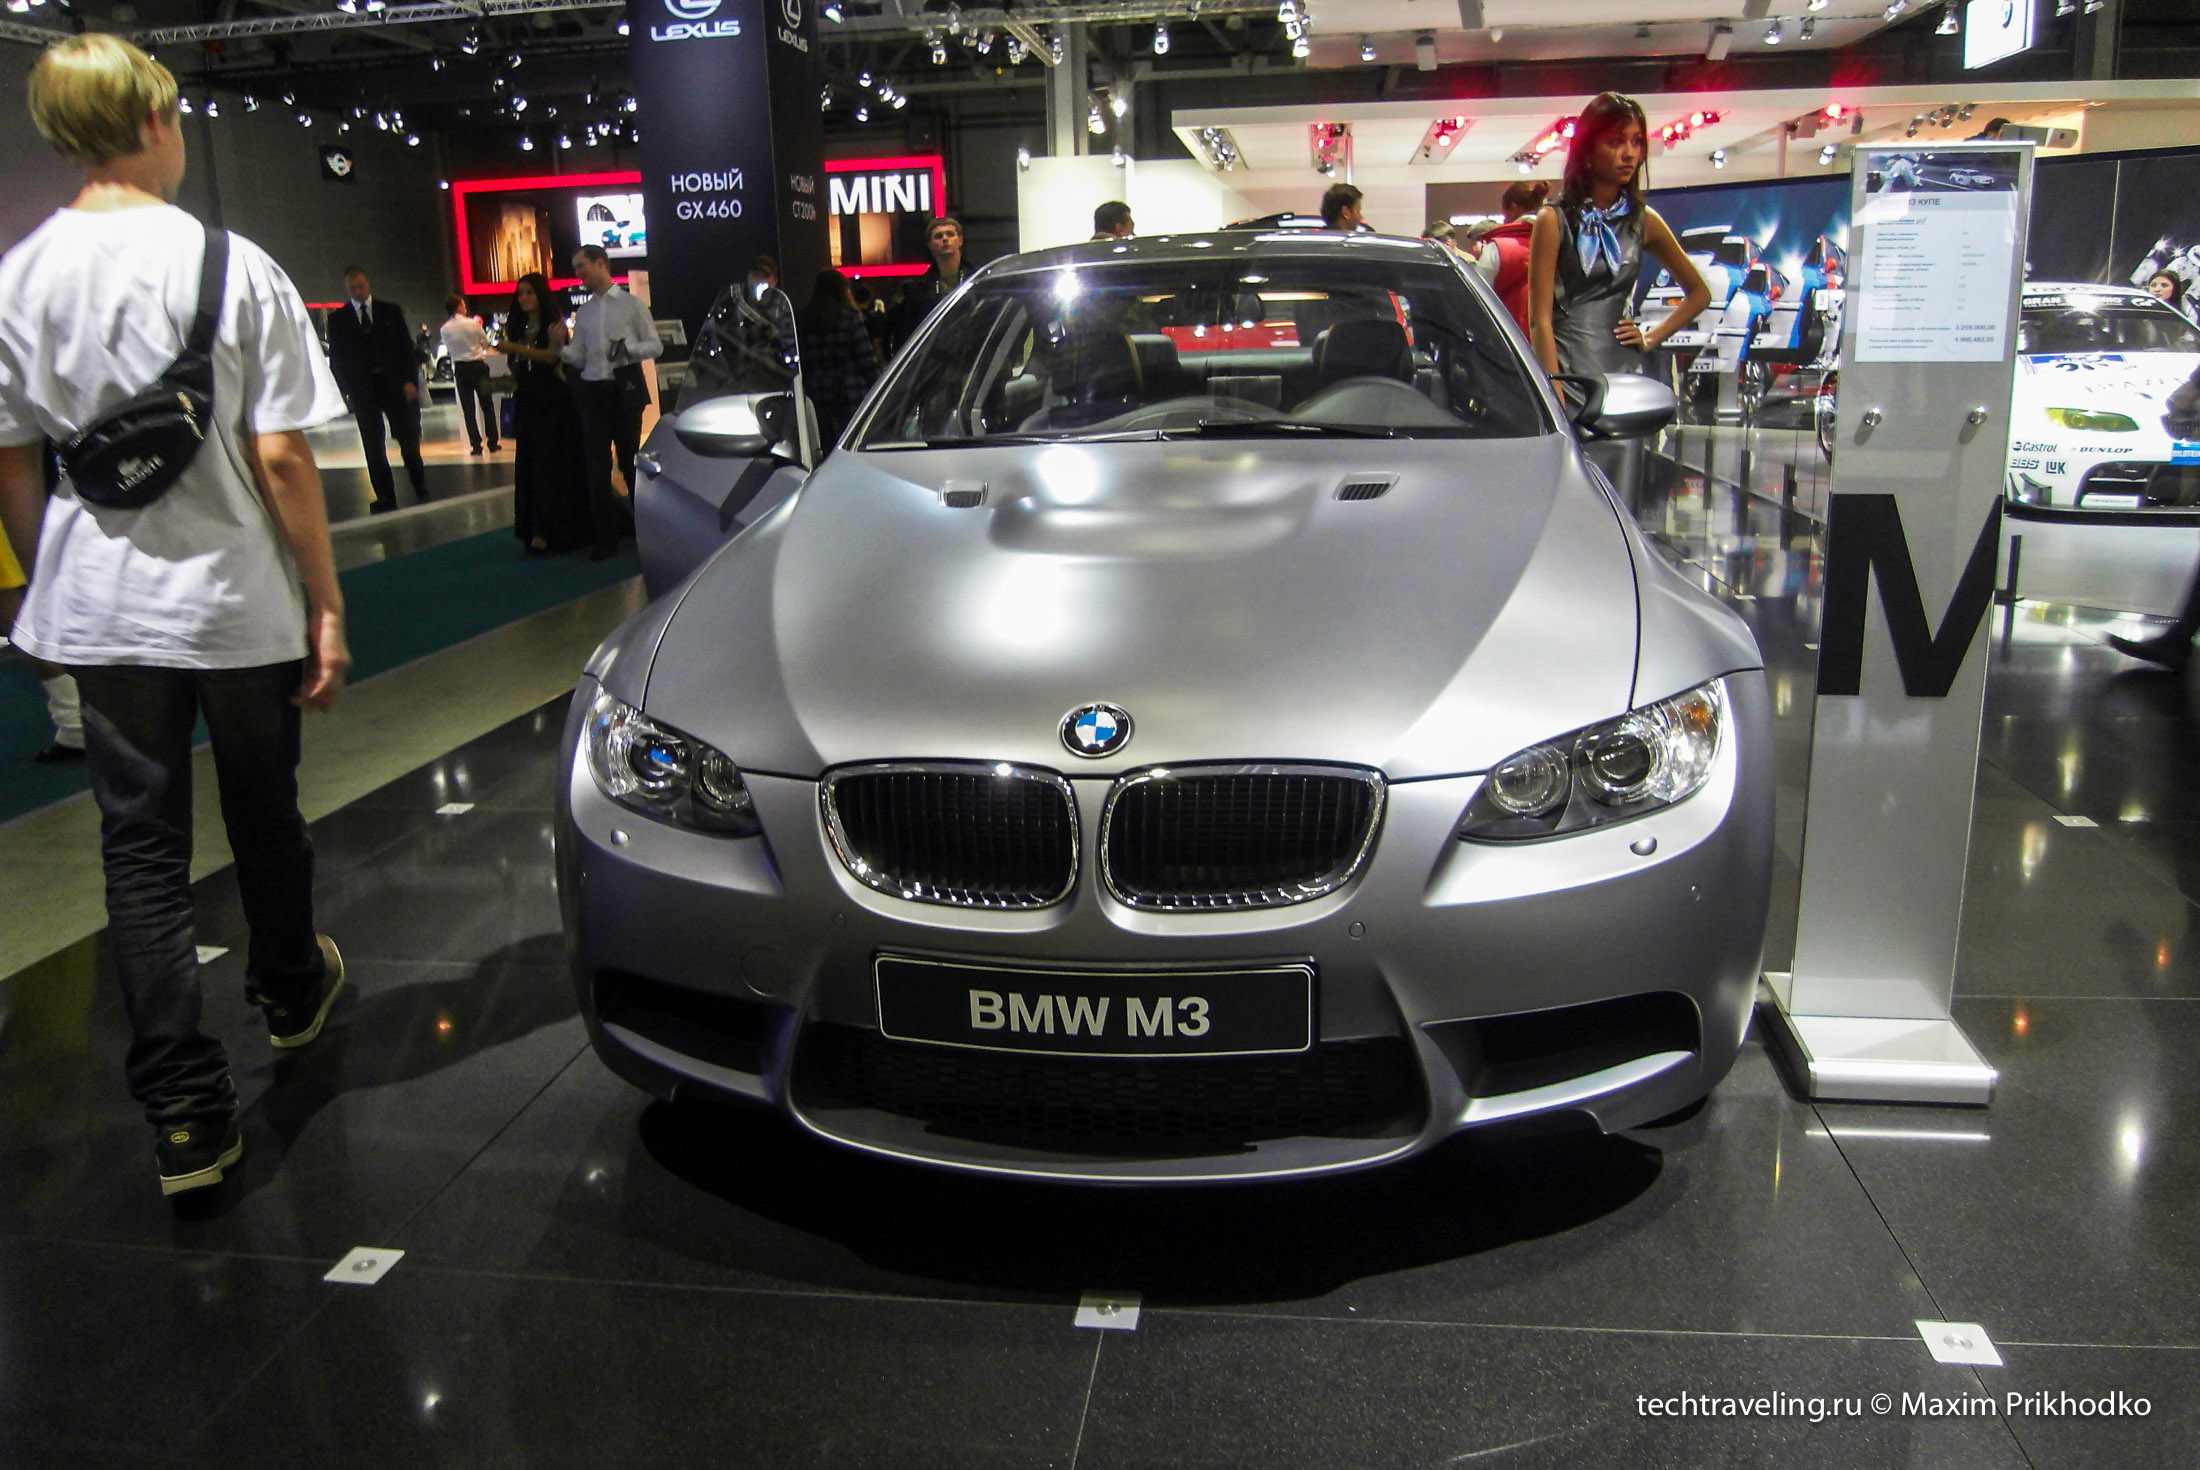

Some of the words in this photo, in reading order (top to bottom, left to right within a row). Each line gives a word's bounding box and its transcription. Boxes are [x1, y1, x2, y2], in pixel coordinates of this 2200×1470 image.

[651, 20, 741, 42] LEXUS
[777, 26, 808, 52] LEXUS
[671, 168, 743, 193] НОВЫЙ
[829, 173, 930, 215] MINI
[676, 201, 703, 220] GX
[706, 199, 742, 219] 460
[2023, 442, 2058, 453] Castrol
[2080, 446, 2133, 454] DUNLOP
[1817, 494, 2004, 697] M
[969, 989, 1110, 1037] BMW
[1126, 997, 1210, 1037] M3
